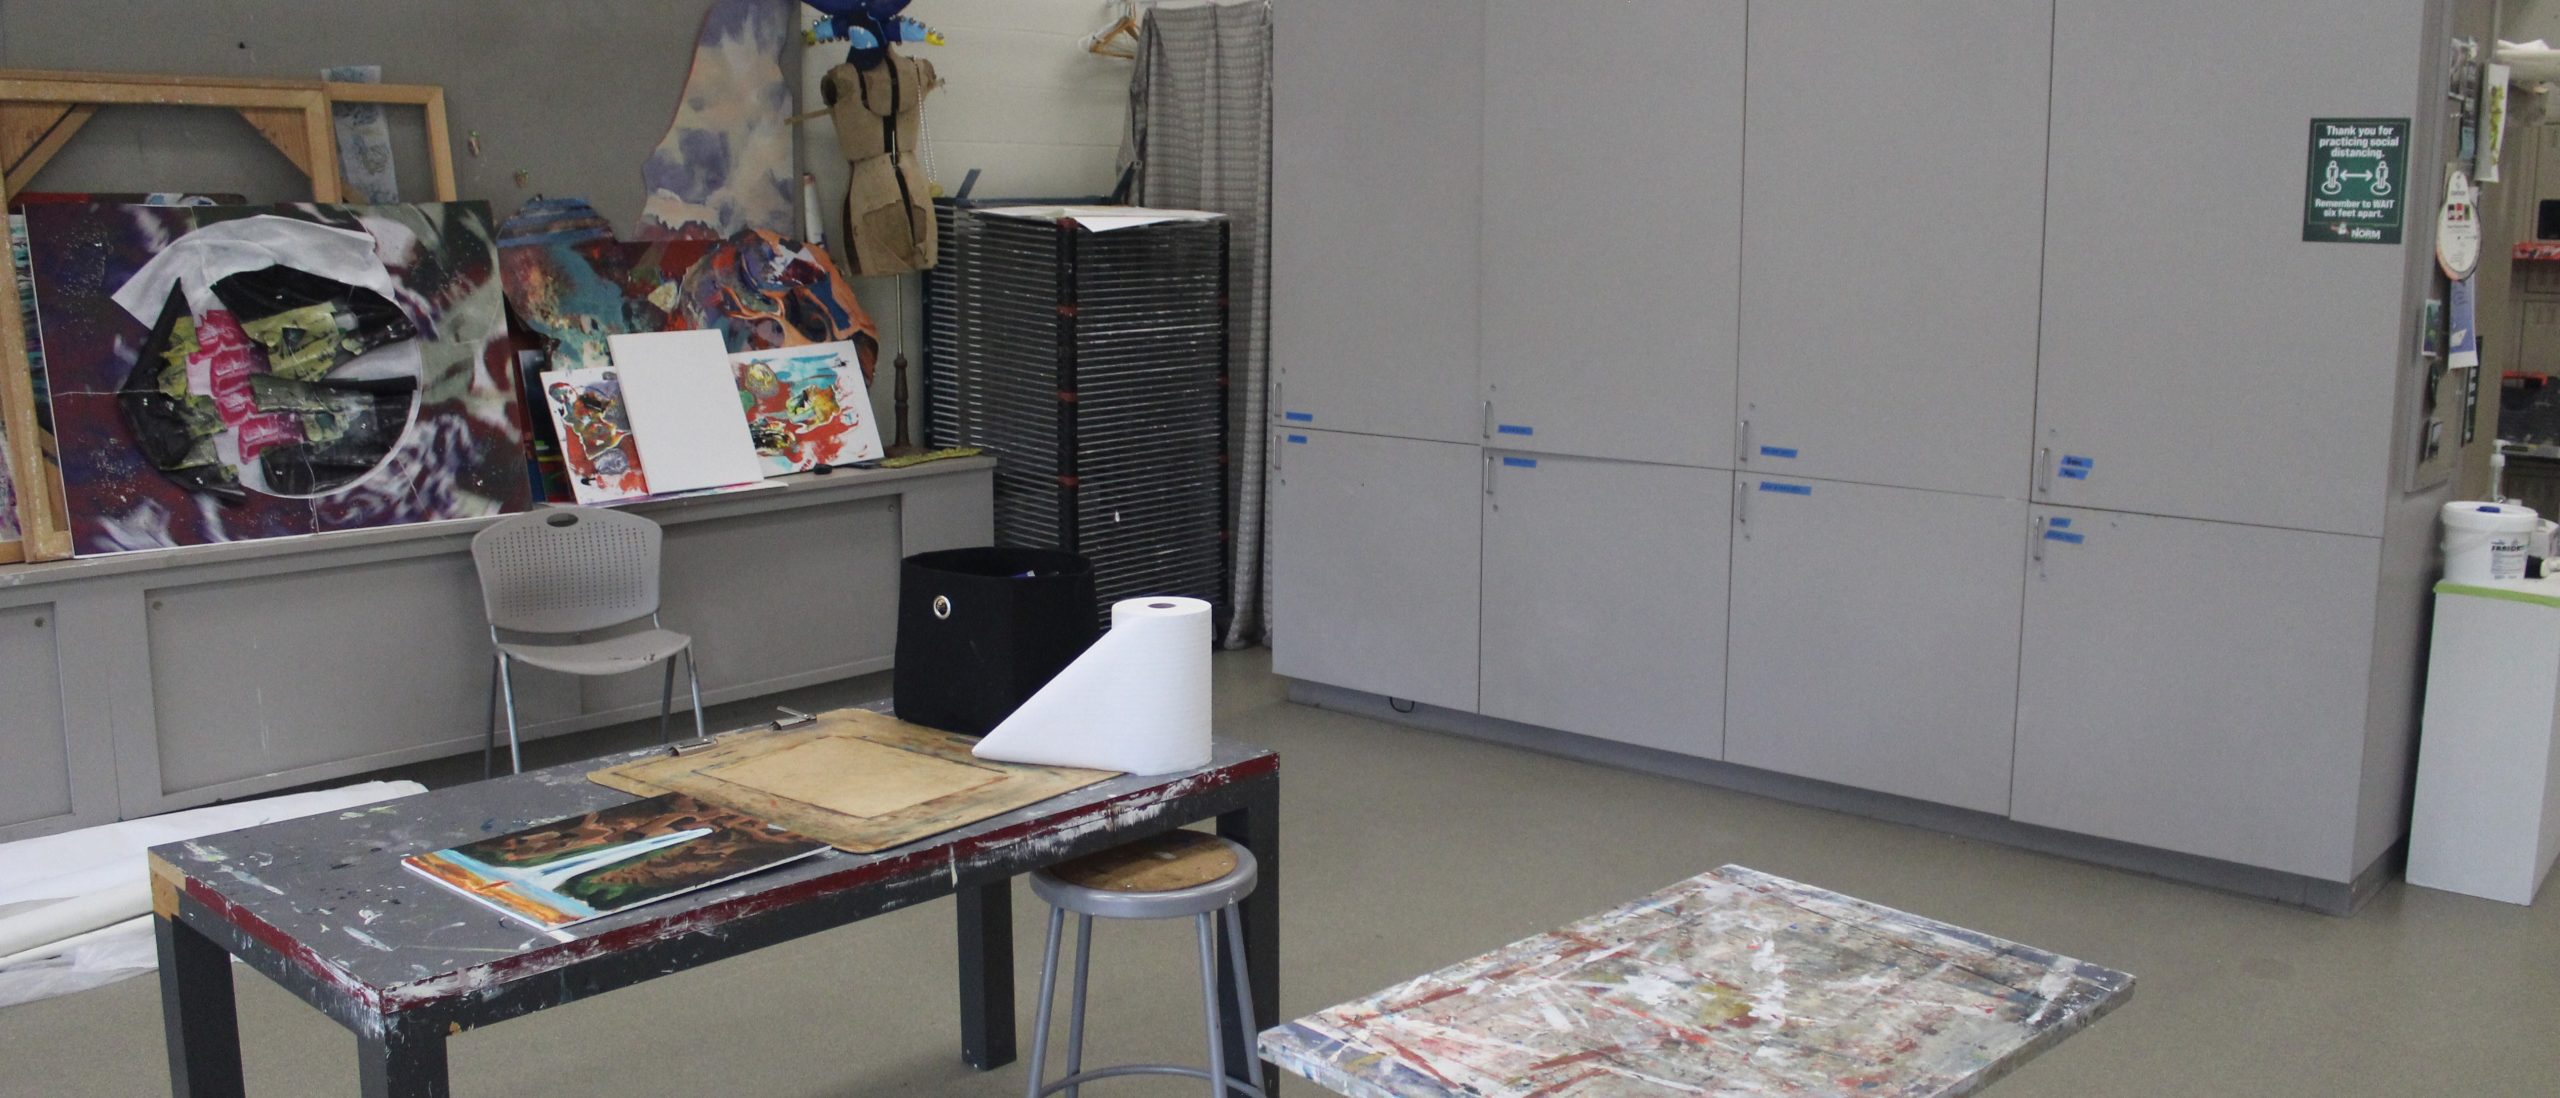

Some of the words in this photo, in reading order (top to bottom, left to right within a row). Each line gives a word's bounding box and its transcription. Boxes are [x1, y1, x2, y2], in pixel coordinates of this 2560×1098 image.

[2326, 125, 2356, 136] Thank
[2358, 126, 2376, 137] you
[2378, 125, 2393, 135] for
[2319, 137, 2369, 148] practicing
[2370, 137, 2399, 147] social
[2331, 149, 2385, 159] distancing.
[2315, 199, 2360, 208] Remember
[2362, 199, 2372, 208] to
[2372, 199, 2395, 209] WAIT
[2323, 208, 2337, 217] six
[2338, 208, 2356, 217] feet
[2357, 209, 2384, 219] apart.
